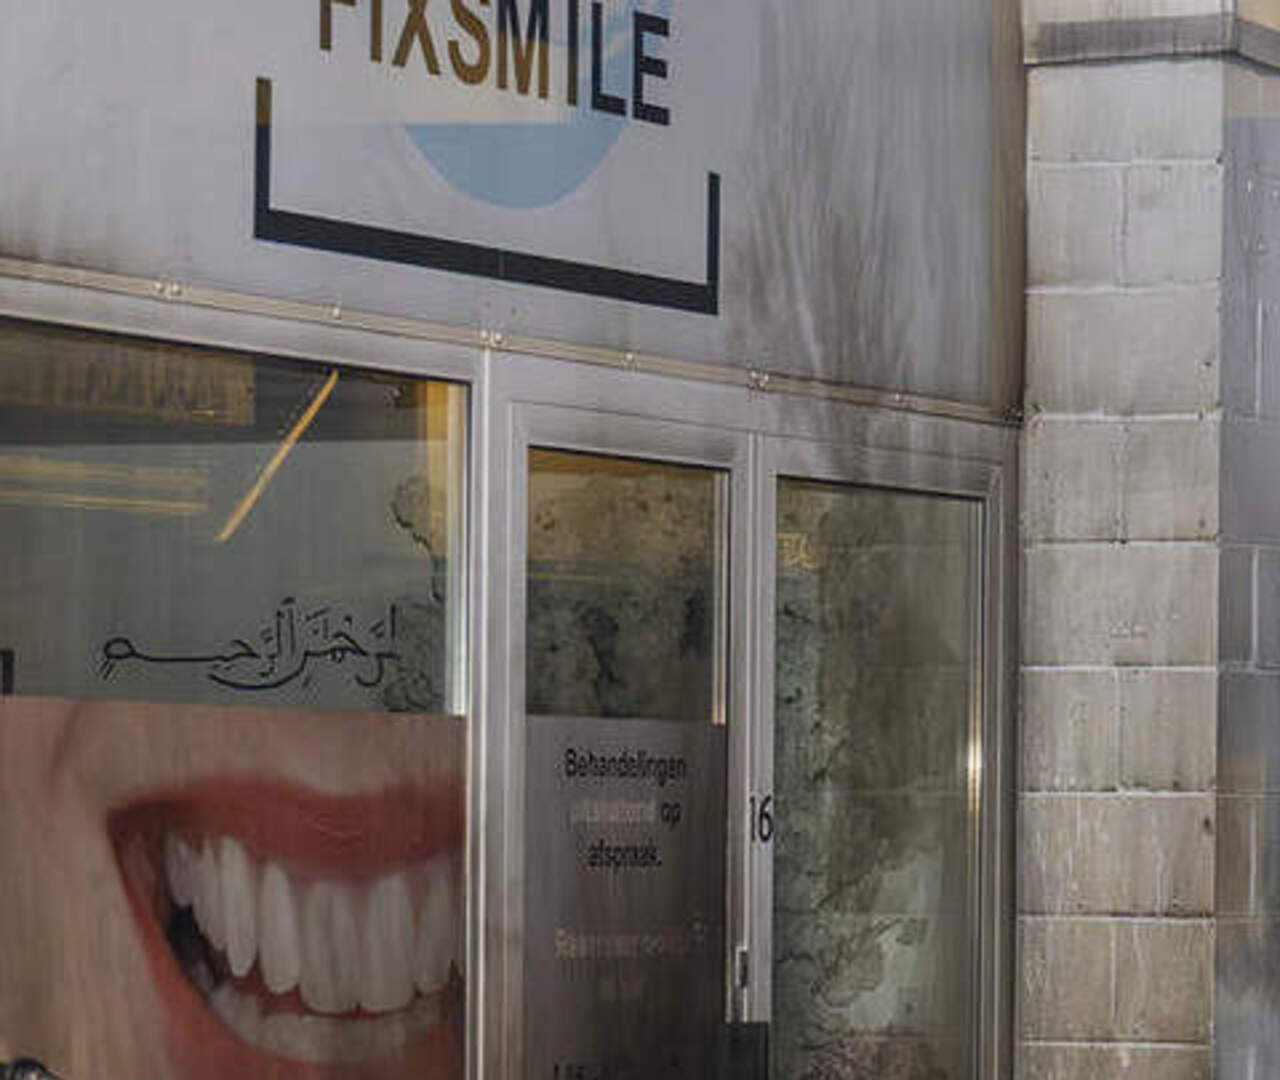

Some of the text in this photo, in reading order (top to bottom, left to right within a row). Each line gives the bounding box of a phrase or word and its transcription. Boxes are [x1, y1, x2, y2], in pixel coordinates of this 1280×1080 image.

[564, 748, 687, 787] Behandelingen
[660, 801, 681, 830] op
[750, 795, 774, 843] 16
